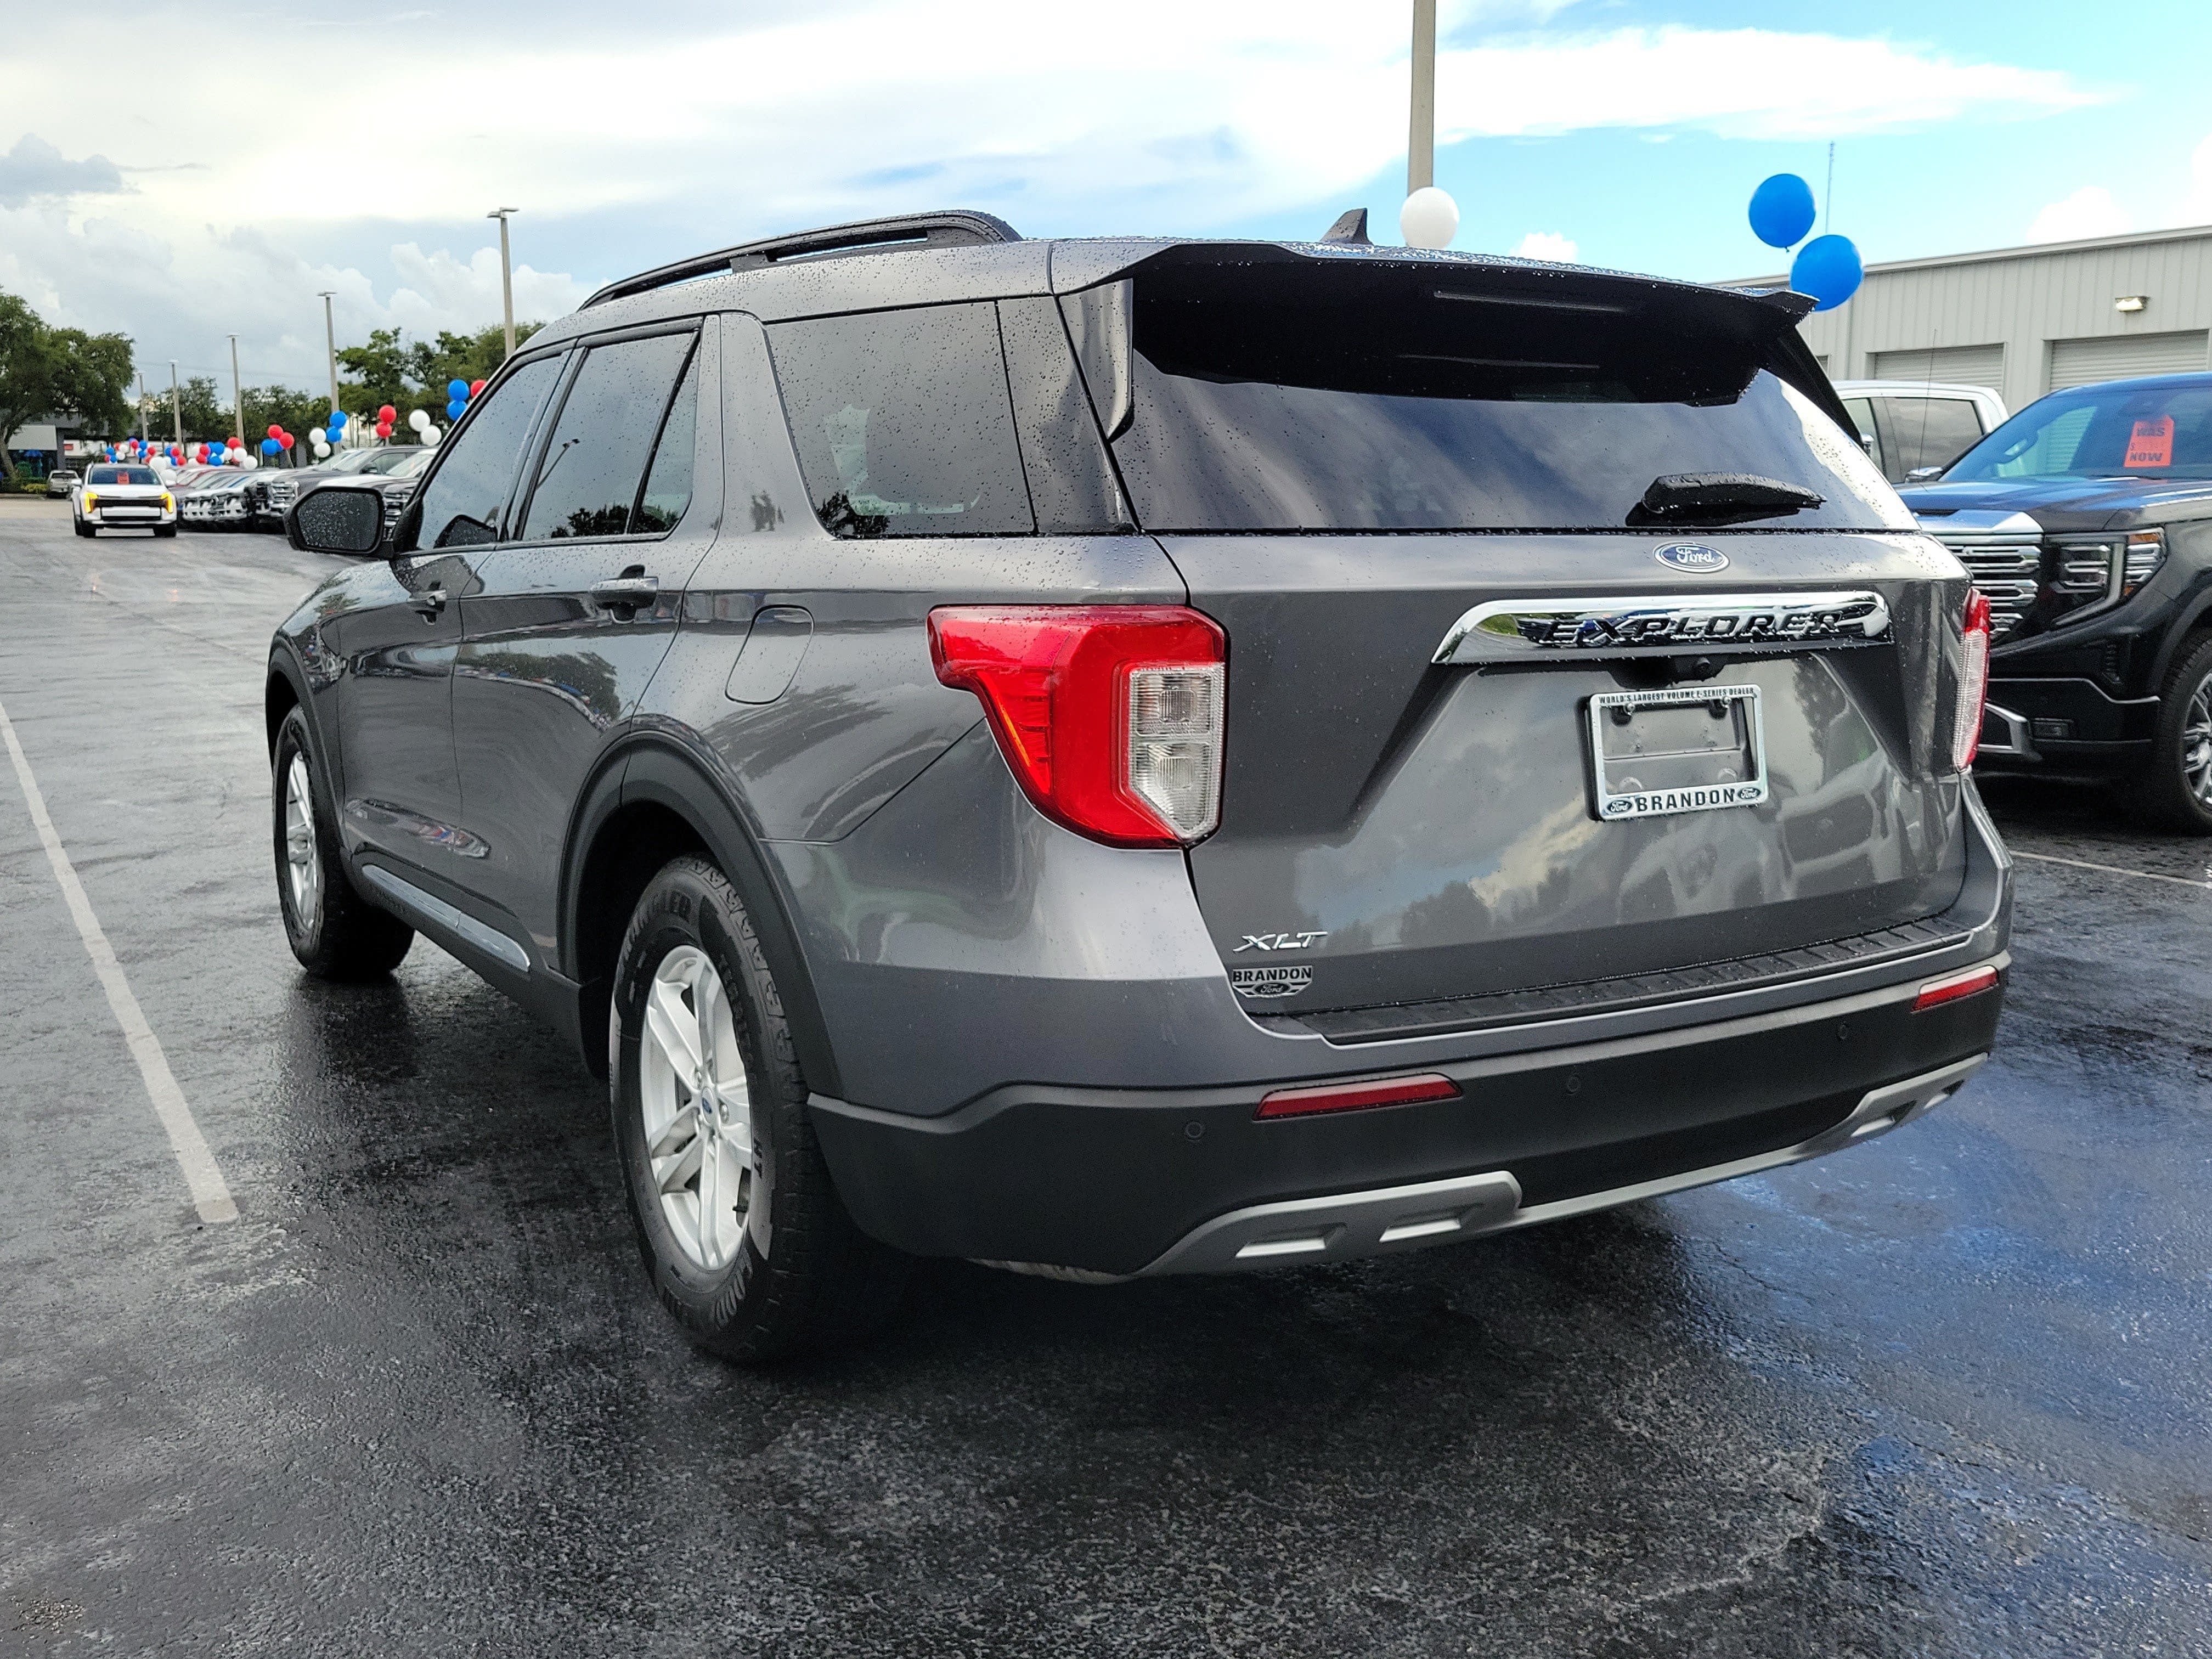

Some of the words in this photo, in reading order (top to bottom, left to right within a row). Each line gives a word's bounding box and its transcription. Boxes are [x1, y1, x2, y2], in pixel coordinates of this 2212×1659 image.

[2130, 452, 2162, 461] NOW
[1675, 546, 1715, 564] Ford
[1538, 609, 1843, 644] EXPLORER
[1599, 695, 1632, 703] WORLD'S
[1634, 692, 1664, 701] LARGEST
[1667, 691, 1694, 699] VOLUME
[1609, 800, 1631, 812] Ford
[1635, 788, 1735, 812] BRANDON
[1740, 787, 1759, 799] Ford
[1233, 931, 1328, 952] XLT
[1232, 967, 1311, 982] BRANDON
[1260, 983, 1284, 994] Ford
